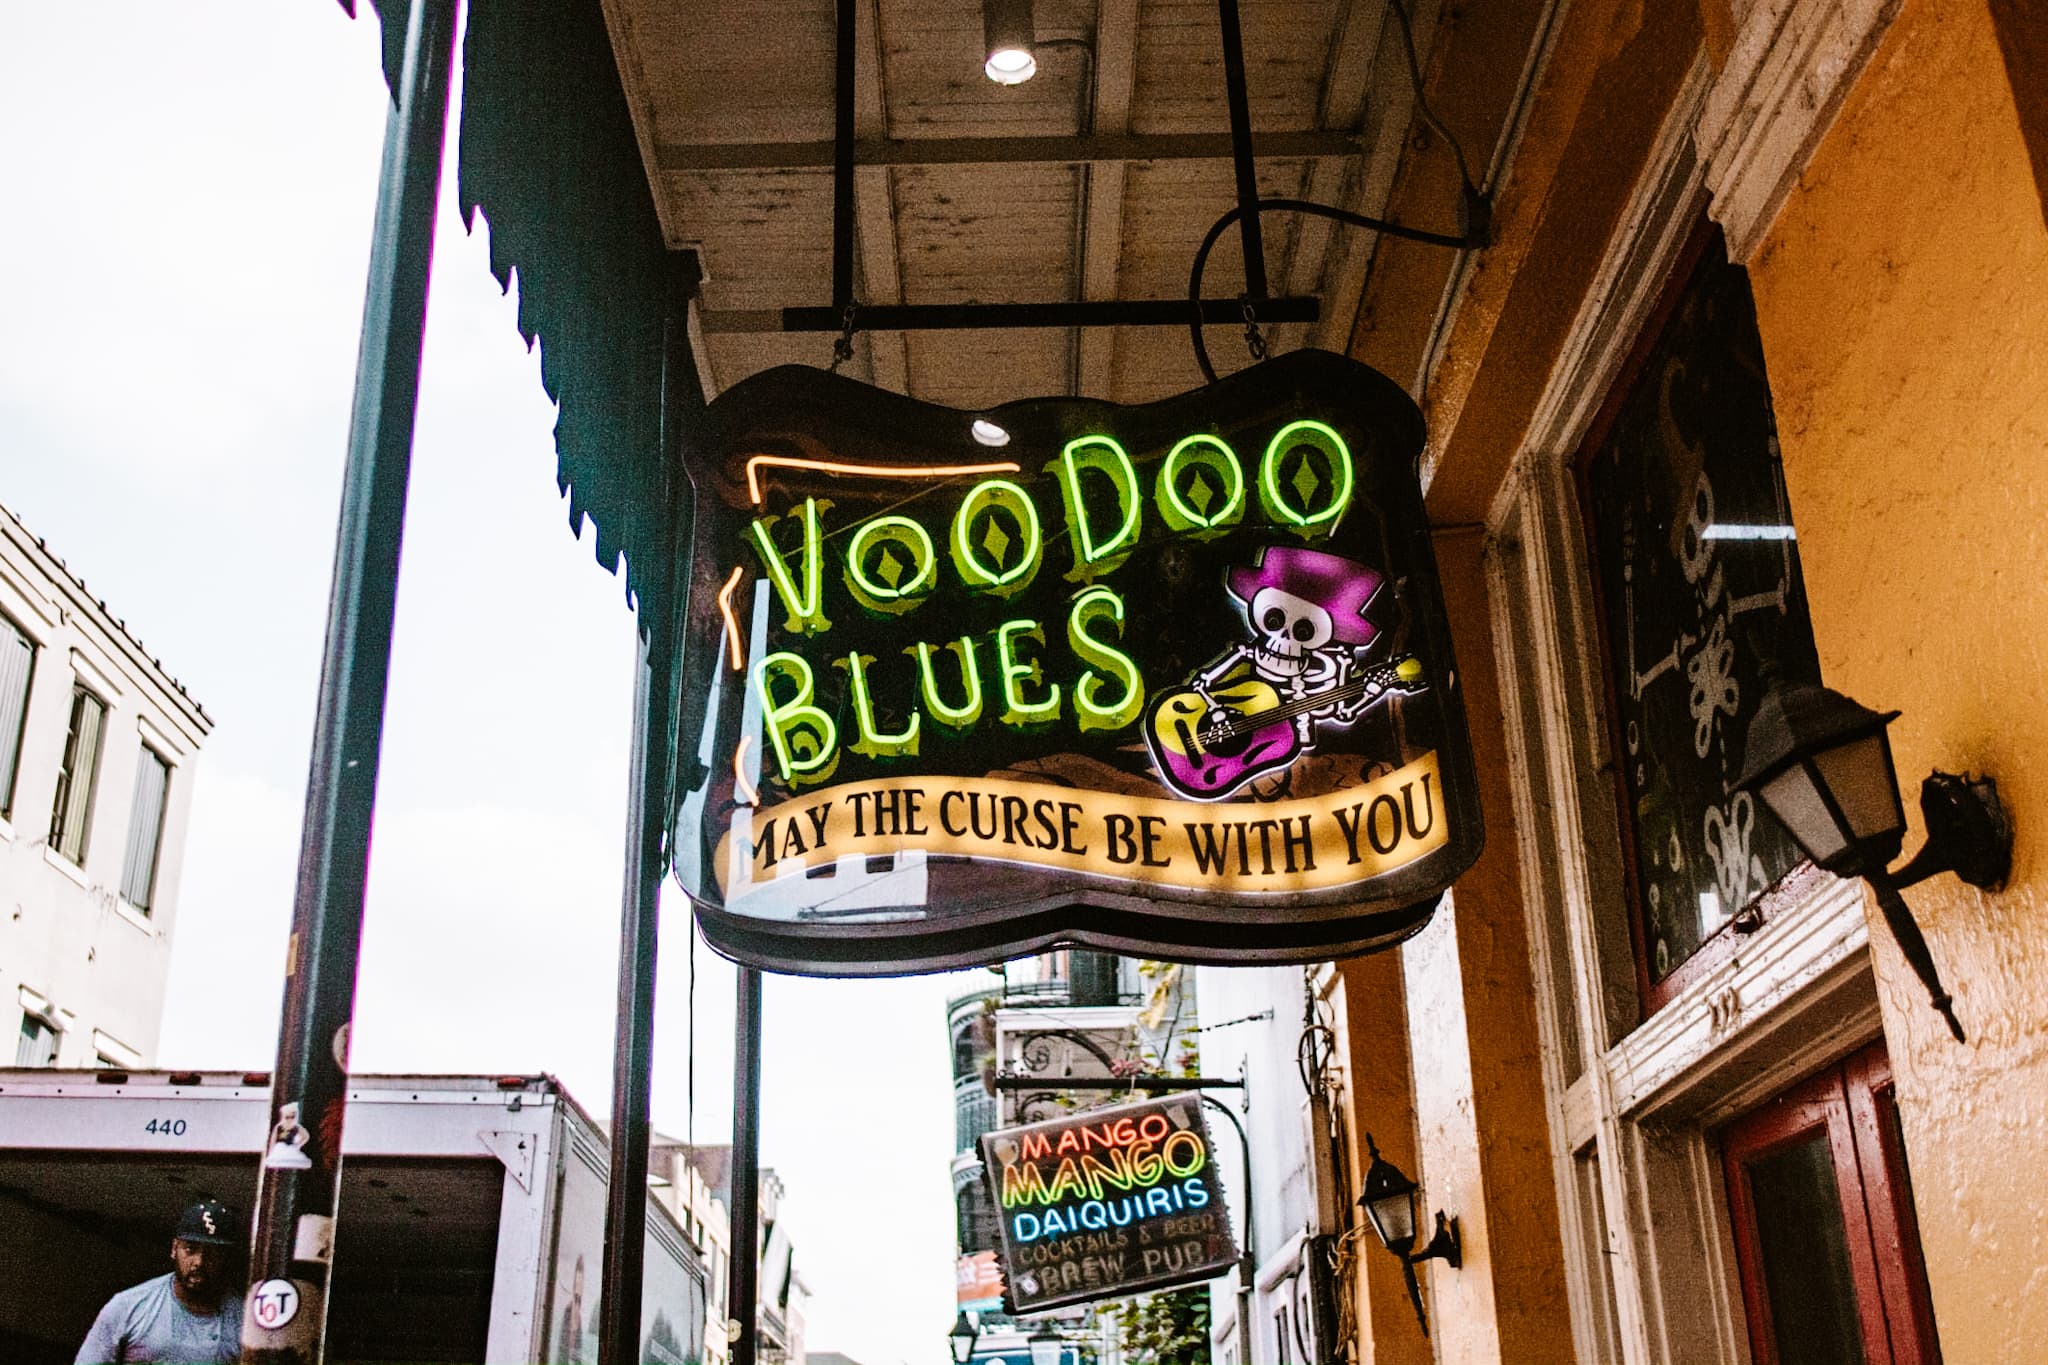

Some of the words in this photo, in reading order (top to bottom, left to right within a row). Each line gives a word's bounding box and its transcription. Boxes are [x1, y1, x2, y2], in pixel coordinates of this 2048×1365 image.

[743, 419, 1354, 636] VOODOO
[752, 584, 1145, 787] BLUES
[736, 802, 832, 883] MAY
[846, 788, 928, 837] THE
[940, 790, 1088, 855] CURSE
[1104, 814, 1172, 867] BE
[1183, 814, 1317, 876] WITH
[1332, 772, 1434, 865] YOU
[145, 1119, 187, 1136] 440
[1021, 1114, 1169, 1161] MANGO
[1002, 1129, 1206, 1209] MANGO
[1014, 1178, 1210, 1243] DAIQUIRIS
[1019, 1227, 1129, 1266] COCKTAILS
[1039, 1249, 1127, 1295] BREW
[1142, 1240, 1205, 1275] PUB
